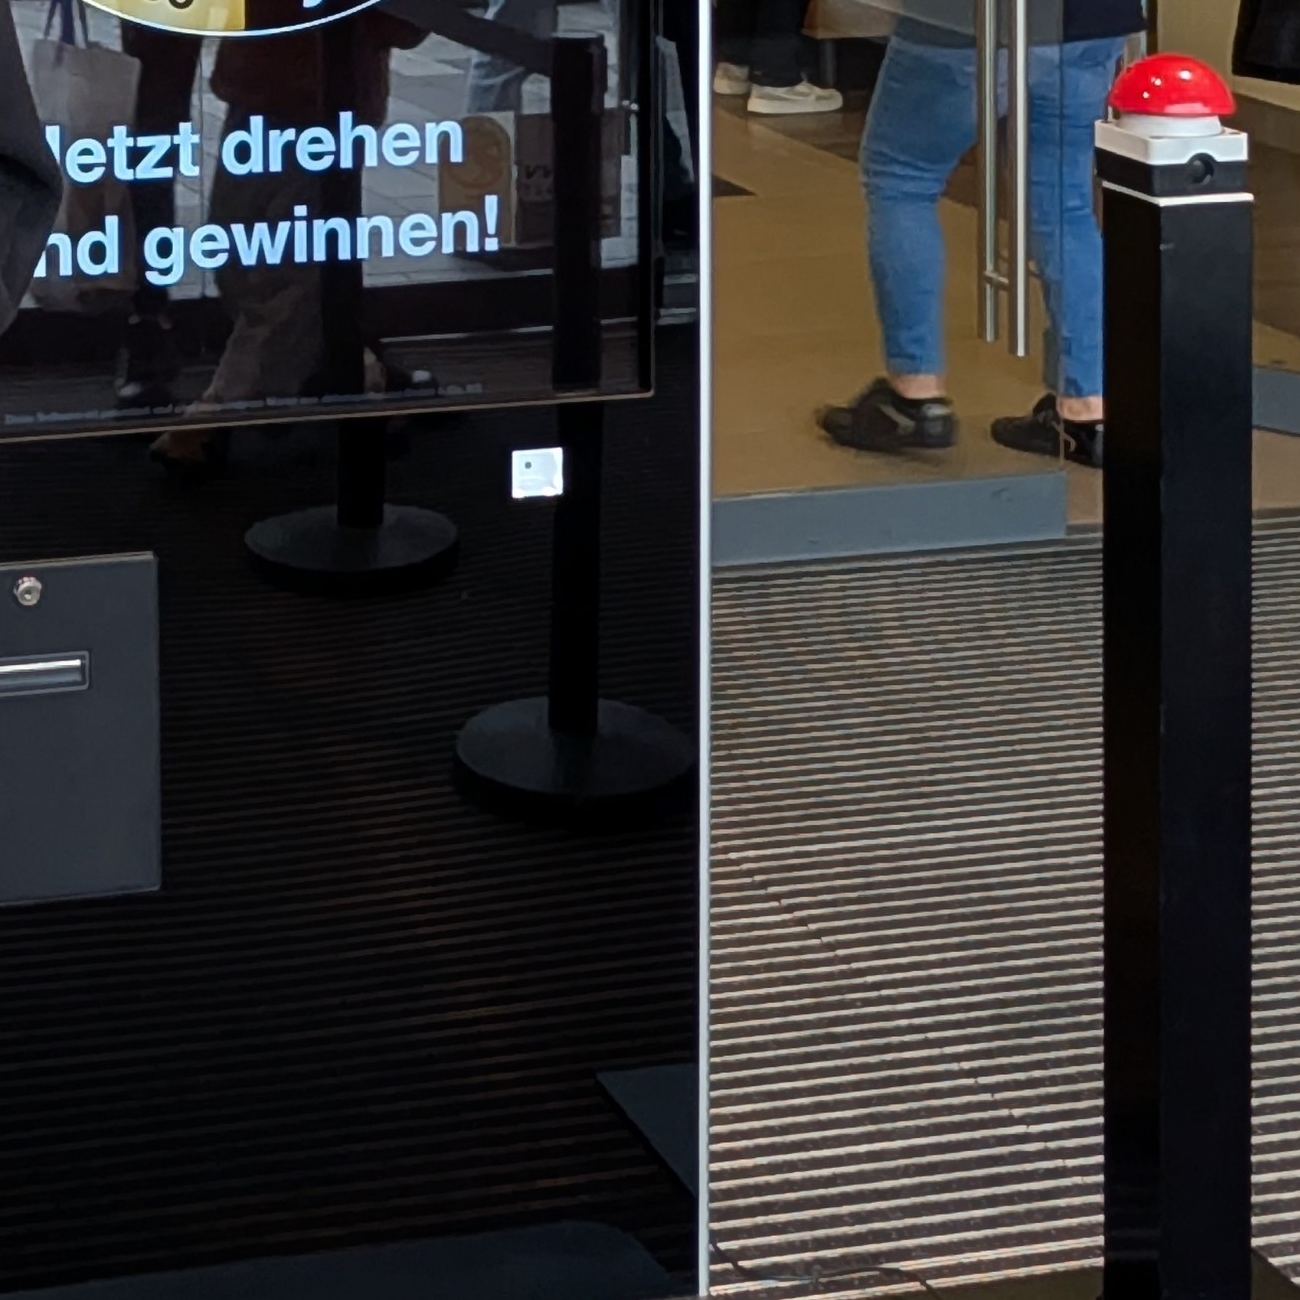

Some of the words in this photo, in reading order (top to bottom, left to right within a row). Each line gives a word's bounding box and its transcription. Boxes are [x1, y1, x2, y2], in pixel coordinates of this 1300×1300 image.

[221, 110, 464, 176] drehen
[33, 214, 121, 279] nd
[143, 194, 500, 287] gewinnen!
